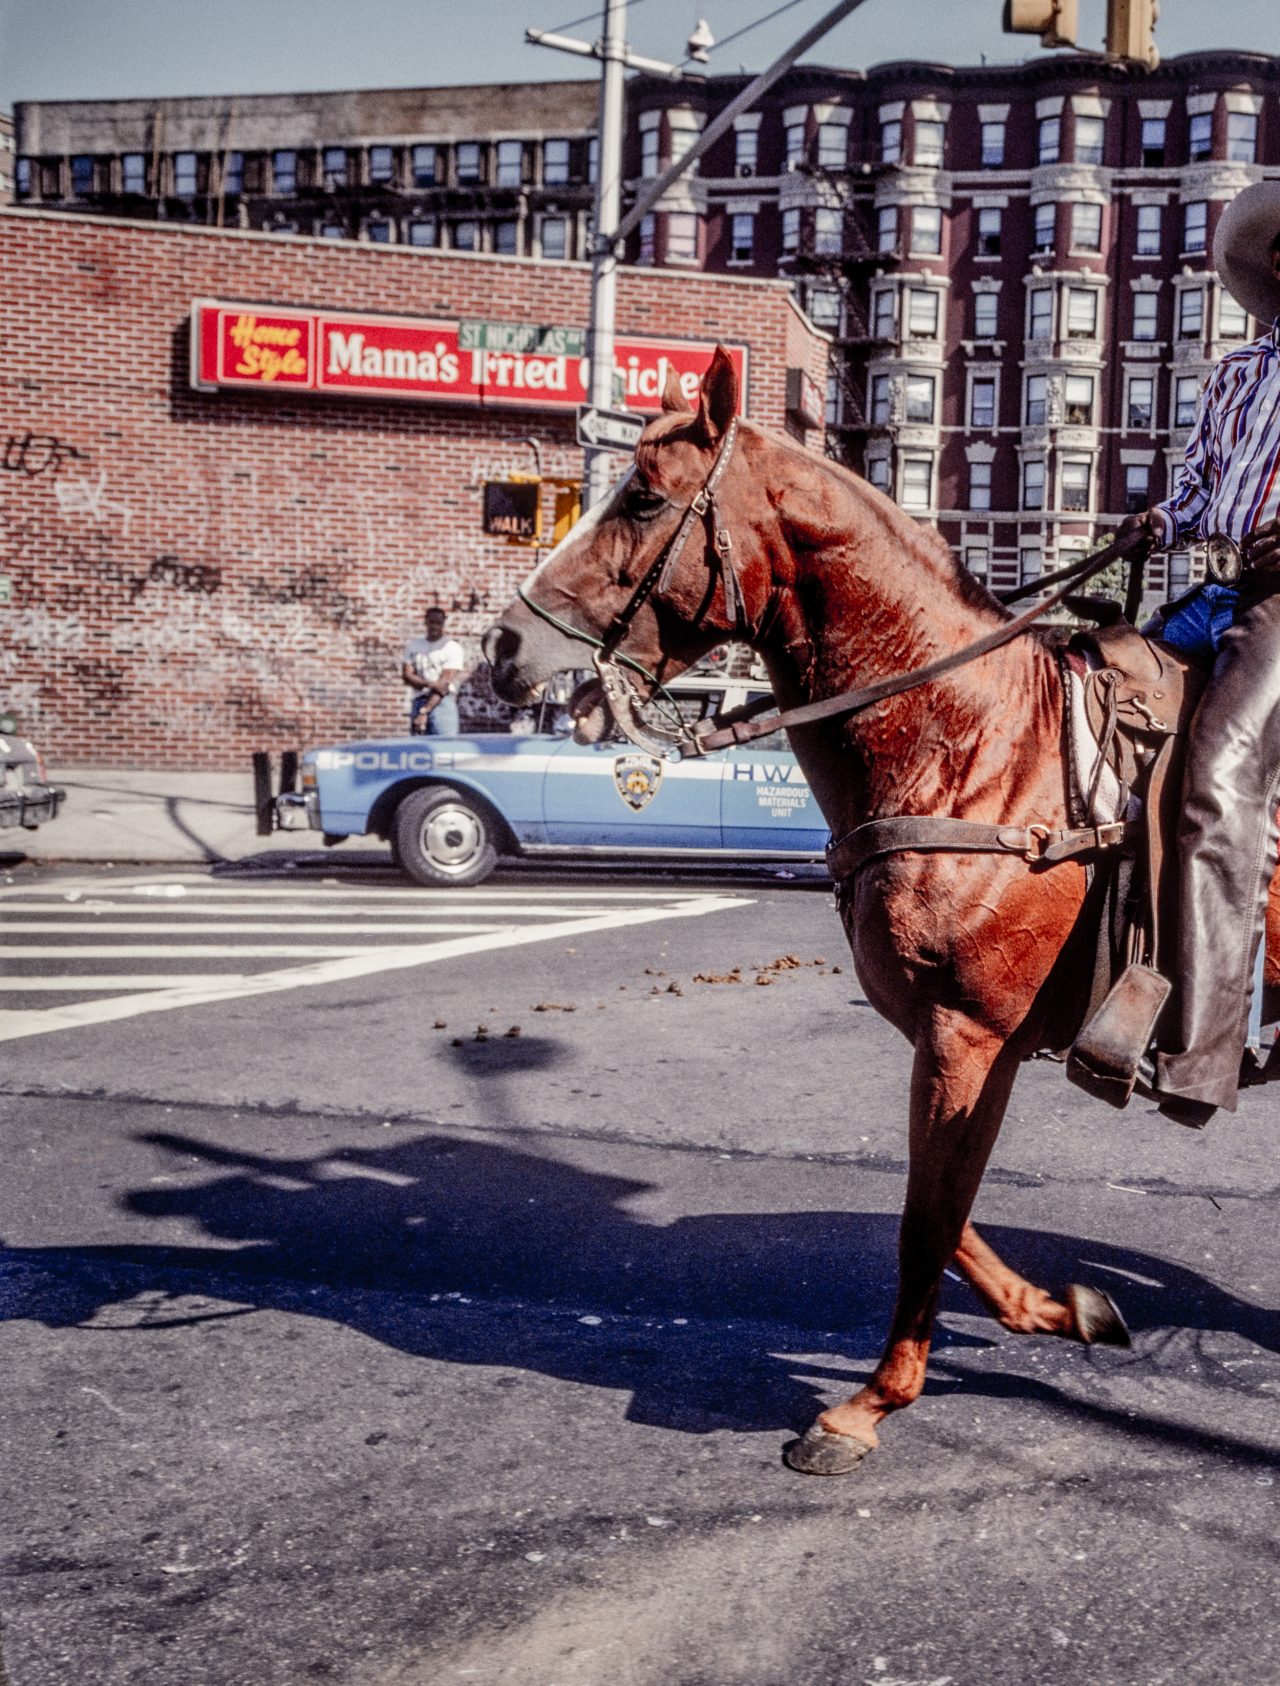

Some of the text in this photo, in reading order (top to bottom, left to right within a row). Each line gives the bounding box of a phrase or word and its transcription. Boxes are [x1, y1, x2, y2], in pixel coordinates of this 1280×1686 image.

[229, 314, 301, 348] Home
[461, 324, 481, 348] ST
[485, 326, 566, 353] NICHOAS
[236, 345, 306, 381] Style
[328, 331, 459, 383] Mama's
[471, 349, 567, 390] Fried
[489, 515, 533, 534] WALK
[331, 751, 454, 771] POLICE
[757, 786, 810, 798] HAZARDOUS
[758, 796, 807, 808] MATERIALS
[771, 807, 793, 818] UNIT
